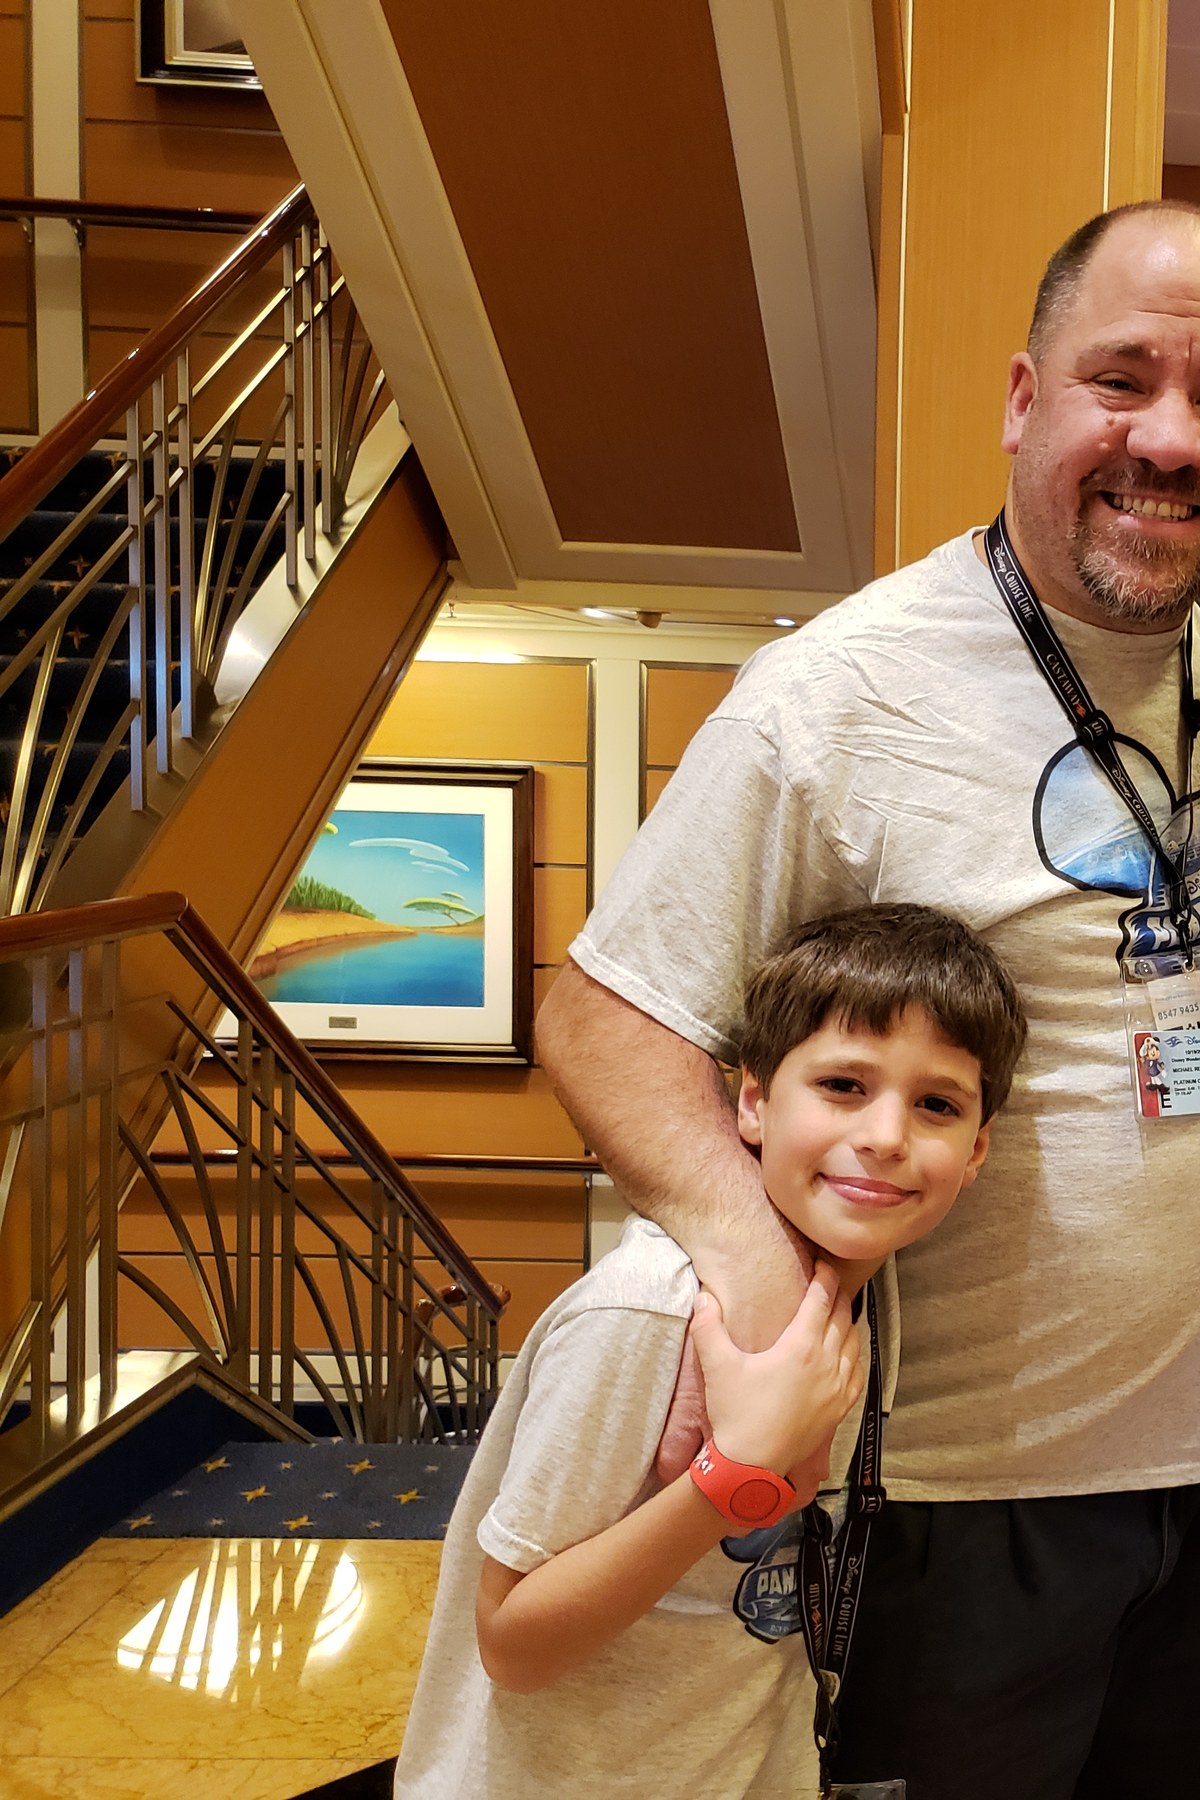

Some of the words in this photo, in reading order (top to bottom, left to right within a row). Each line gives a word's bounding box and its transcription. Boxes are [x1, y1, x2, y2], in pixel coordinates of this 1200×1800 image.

[1046, 653, 1080, 706] CASTAWAY
[1157, 1008, 1177, 1021] 8547
[1180, 1003, 1200, 1015] 9435
